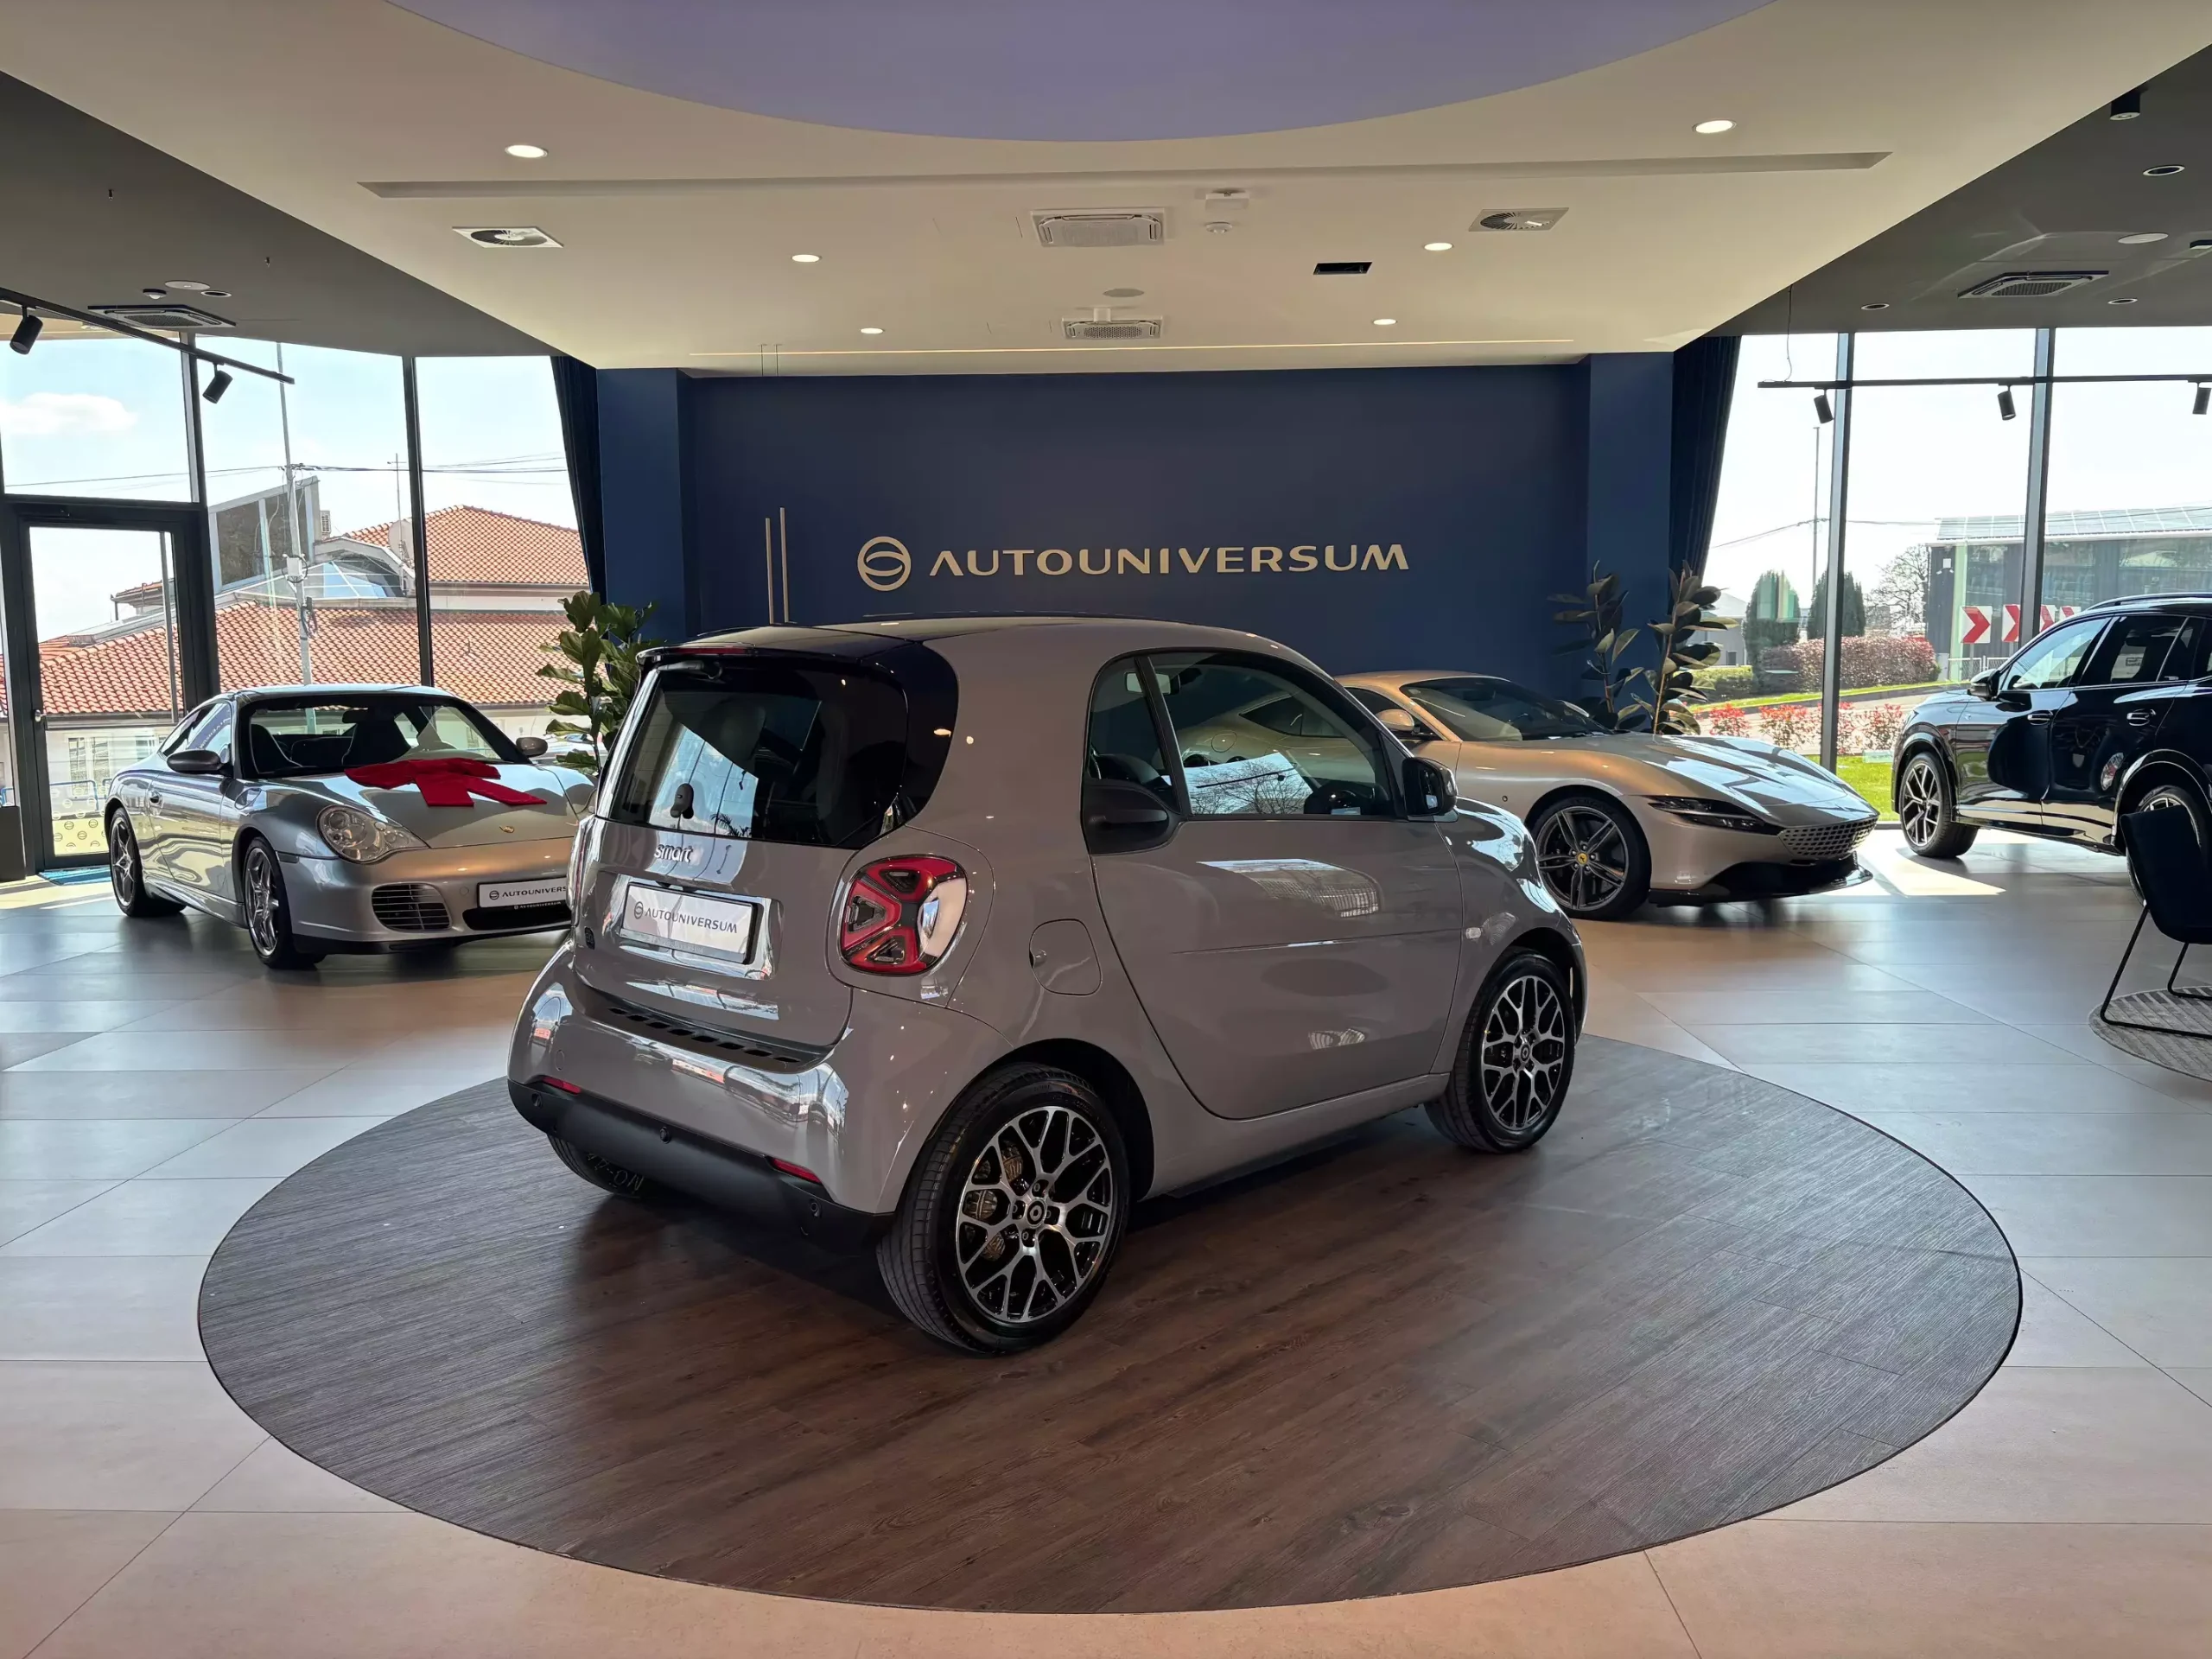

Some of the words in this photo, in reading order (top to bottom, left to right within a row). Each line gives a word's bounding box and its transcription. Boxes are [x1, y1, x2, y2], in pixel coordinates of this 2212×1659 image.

[929, 543, 1409, 576] AUTOUNIVERSUM
[653, 843, 693, 863] smart
[502, 886, 567, 898] AUTOUNIVERS
[645, 907, 738, 934] AUTOUNIVERSUM
